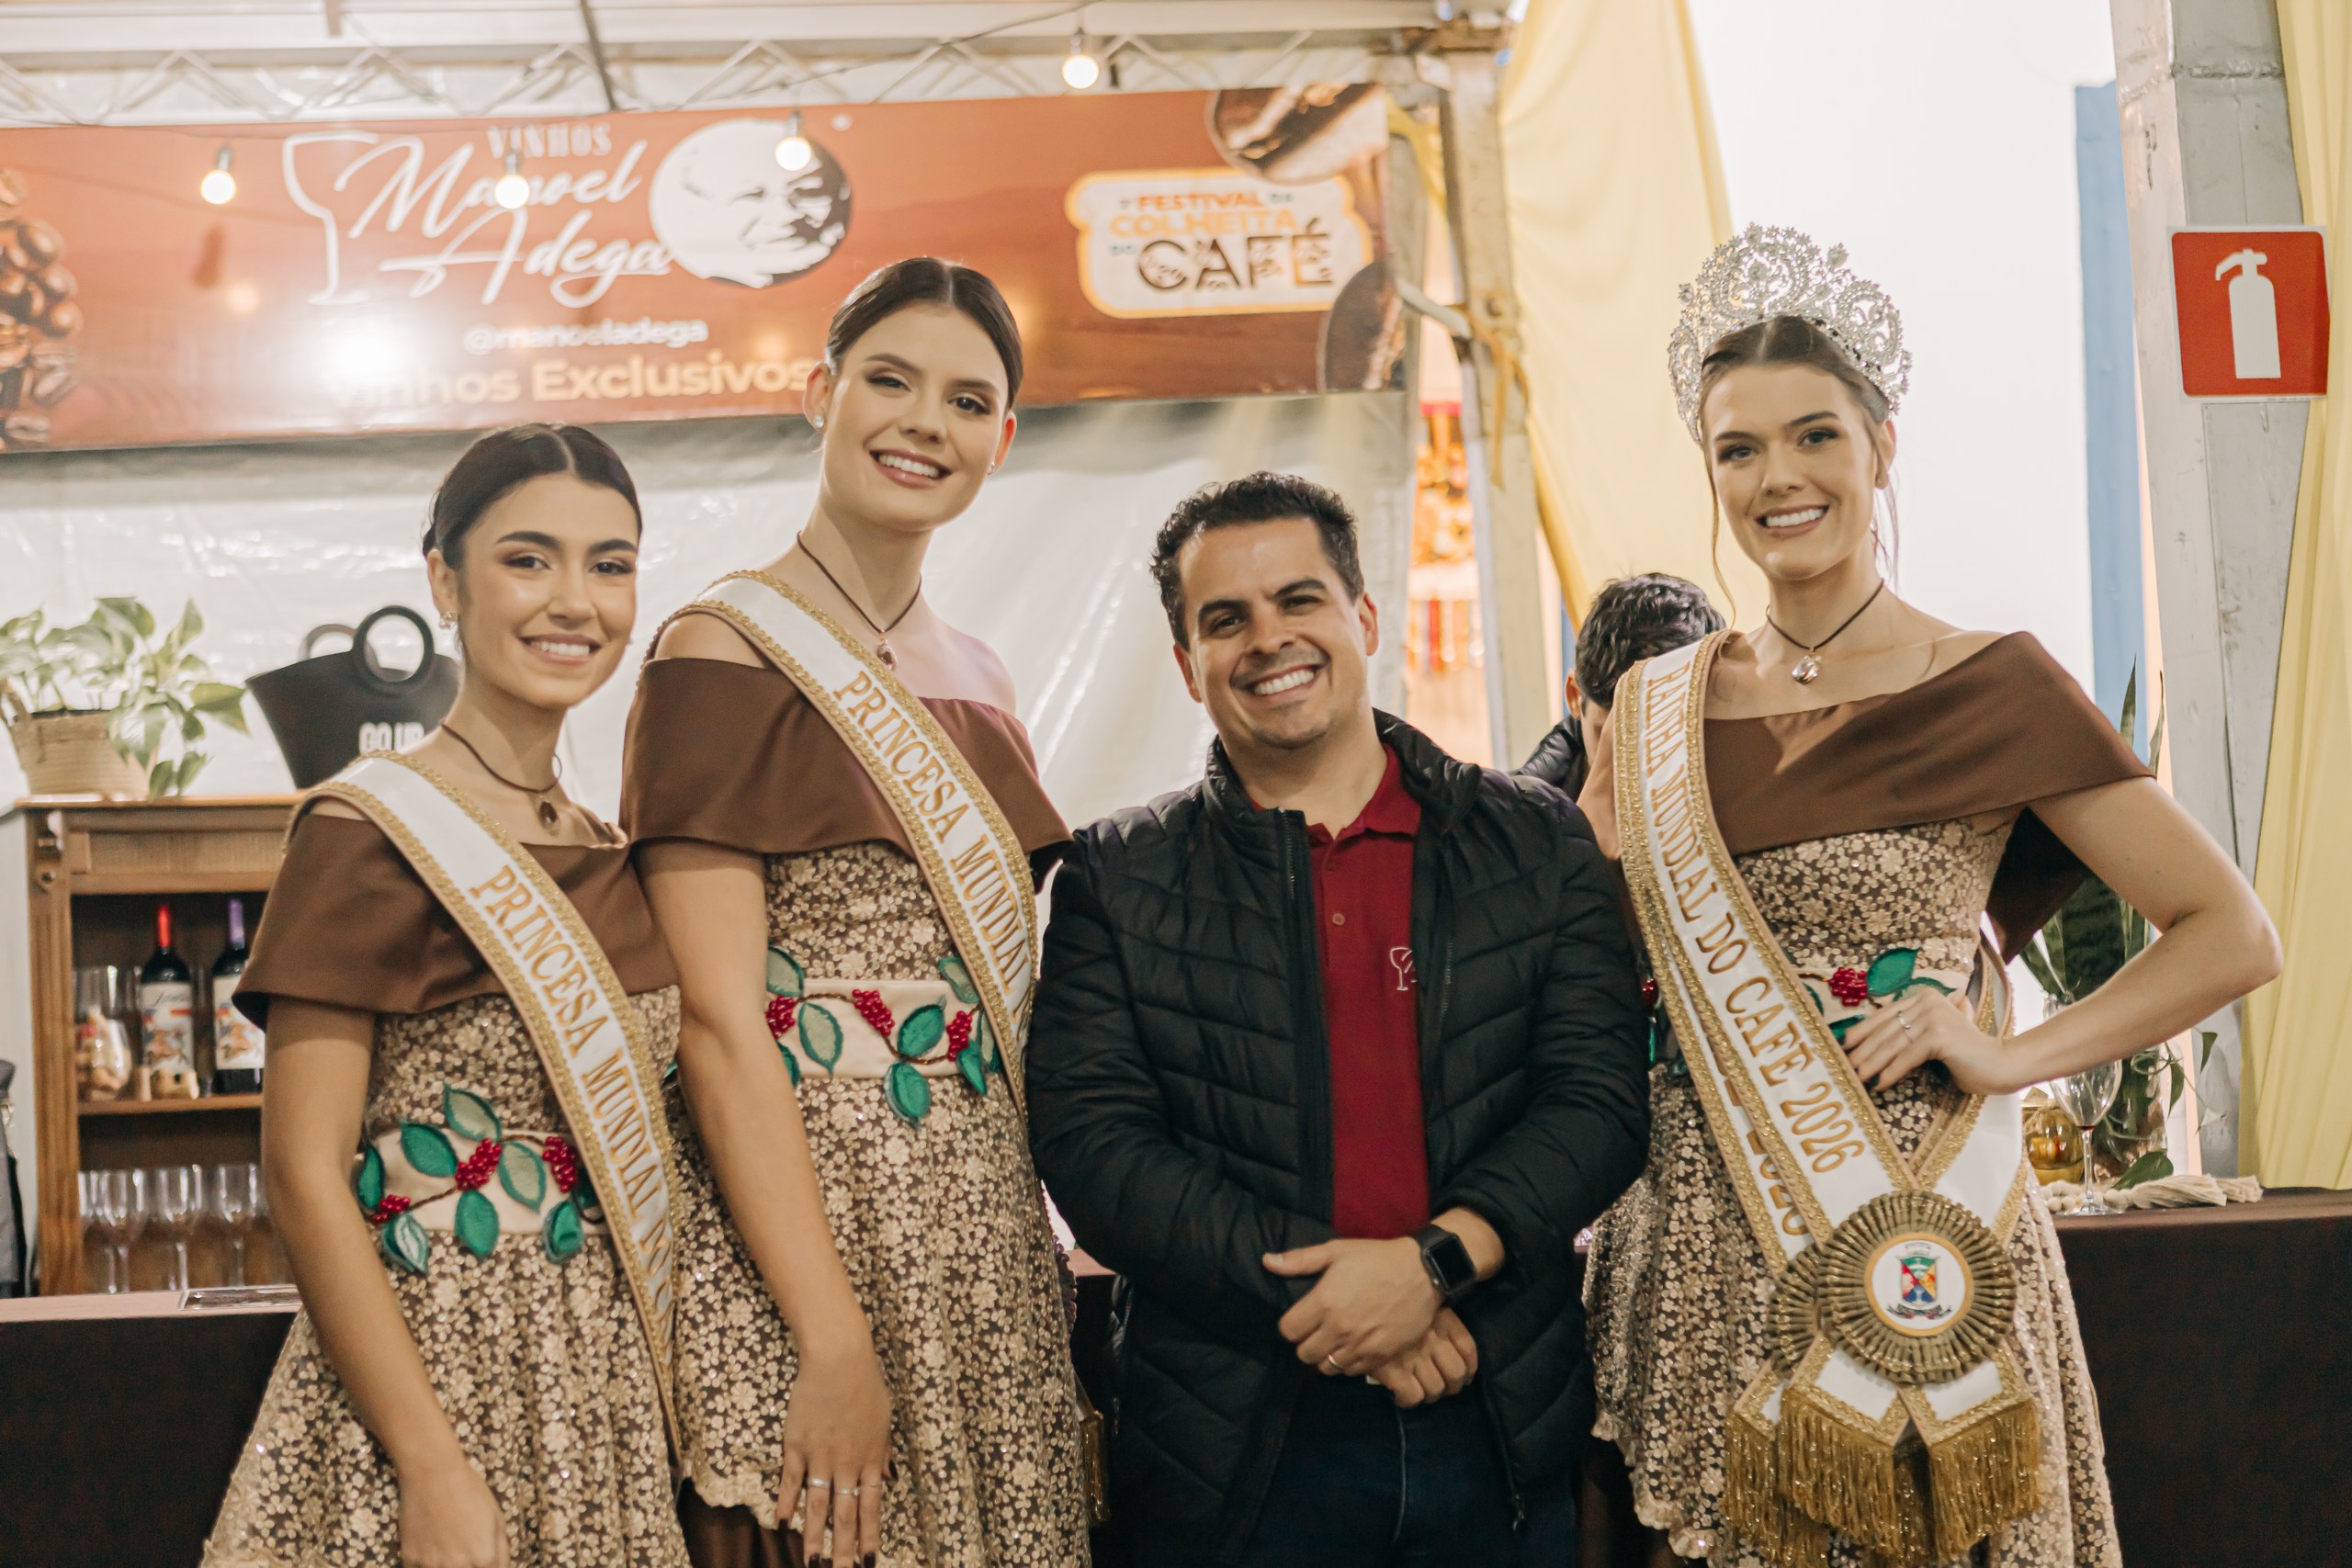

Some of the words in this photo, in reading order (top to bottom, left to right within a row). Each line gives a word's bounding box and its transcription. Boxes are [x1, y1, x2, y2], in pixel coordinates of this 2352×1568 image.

[486, 122, 612, 159] VINHOS
[1109, 208, 1299, 238] COLHEITA
[1136, 191, 1264, 211] FESTIVAL
[379, 207, 678, 309] Adega
[1137, 217, 1334, 291] CAFÉ
[463, 317, 709, 355] @manoeladega
[531, 348, 810, 401] Exclusivos
[1645, 660, 1691, 778] RAINHA
[832, 670, 970, 846] PRINCESA
[949, 833, 1029, 996] MUNDIAL
[1651, 763, 1719, 923] MUNDIAL
[1695, 911, 1749, 976] DO
[469, 864, 610, 1058] PRINCESA
[581, 1051, 662, 1223] MUNDIAL
[1725, 976, 1815, 1088] CAFE
[1780, 1080, 1865, 1175] 2026
